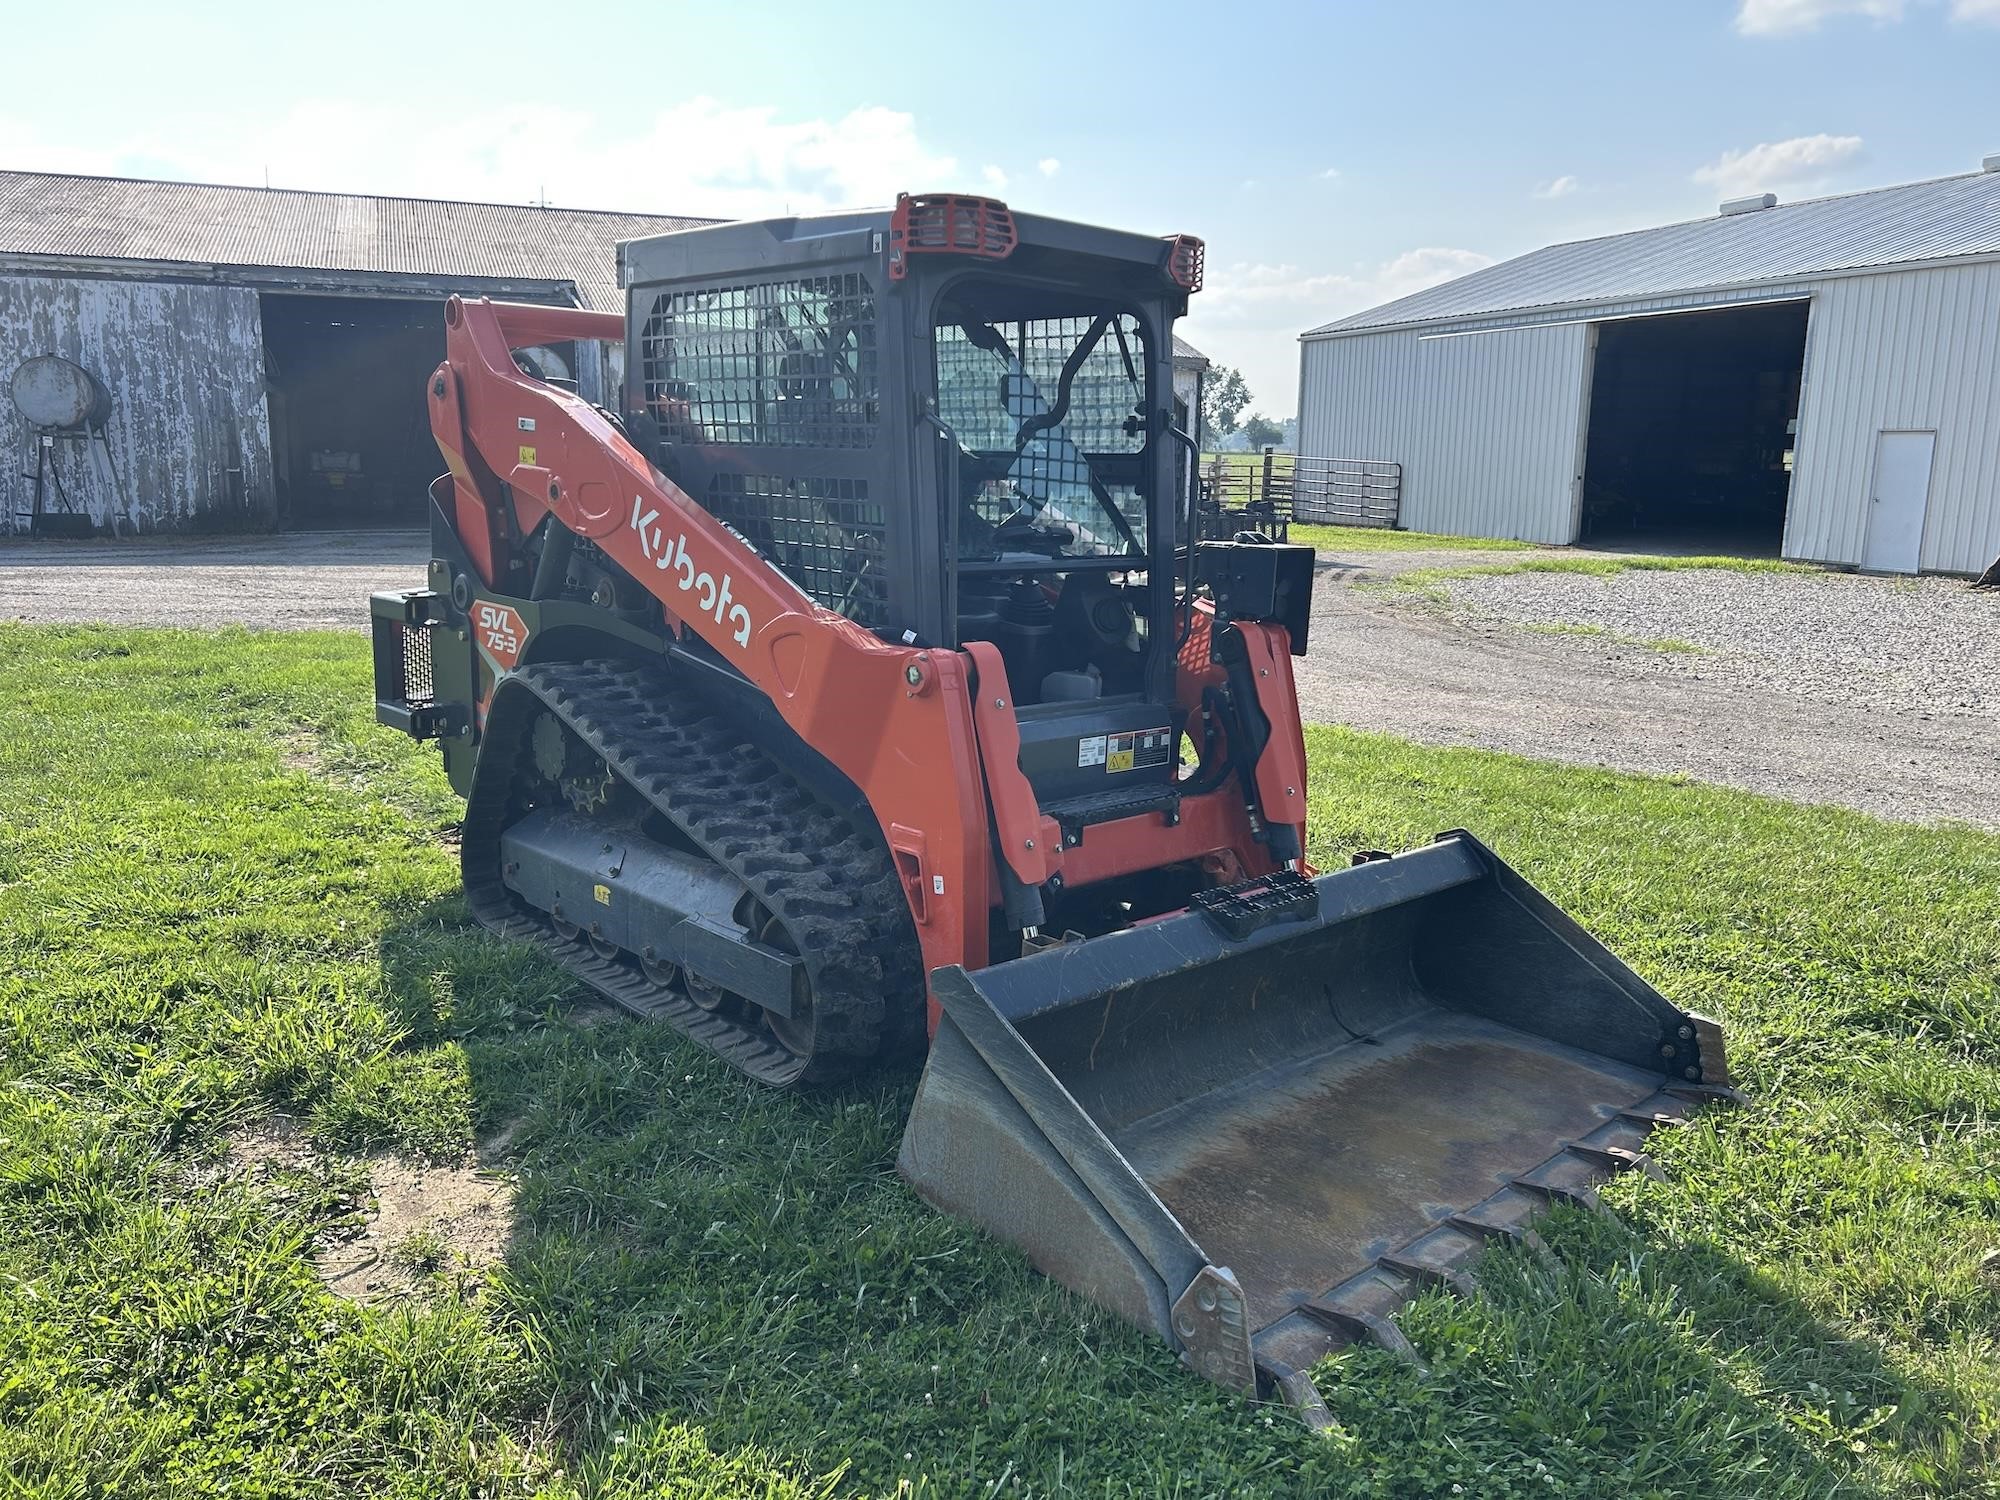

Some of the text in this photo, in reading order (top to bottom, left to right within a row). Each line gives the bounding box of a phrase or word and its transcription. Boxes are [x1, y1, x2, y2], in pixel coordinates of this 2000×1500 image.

[631, 495, 751, 648] Kubota
[480, 607, 514, 634] SVL
[487, 631, 517, 654] 75-3
